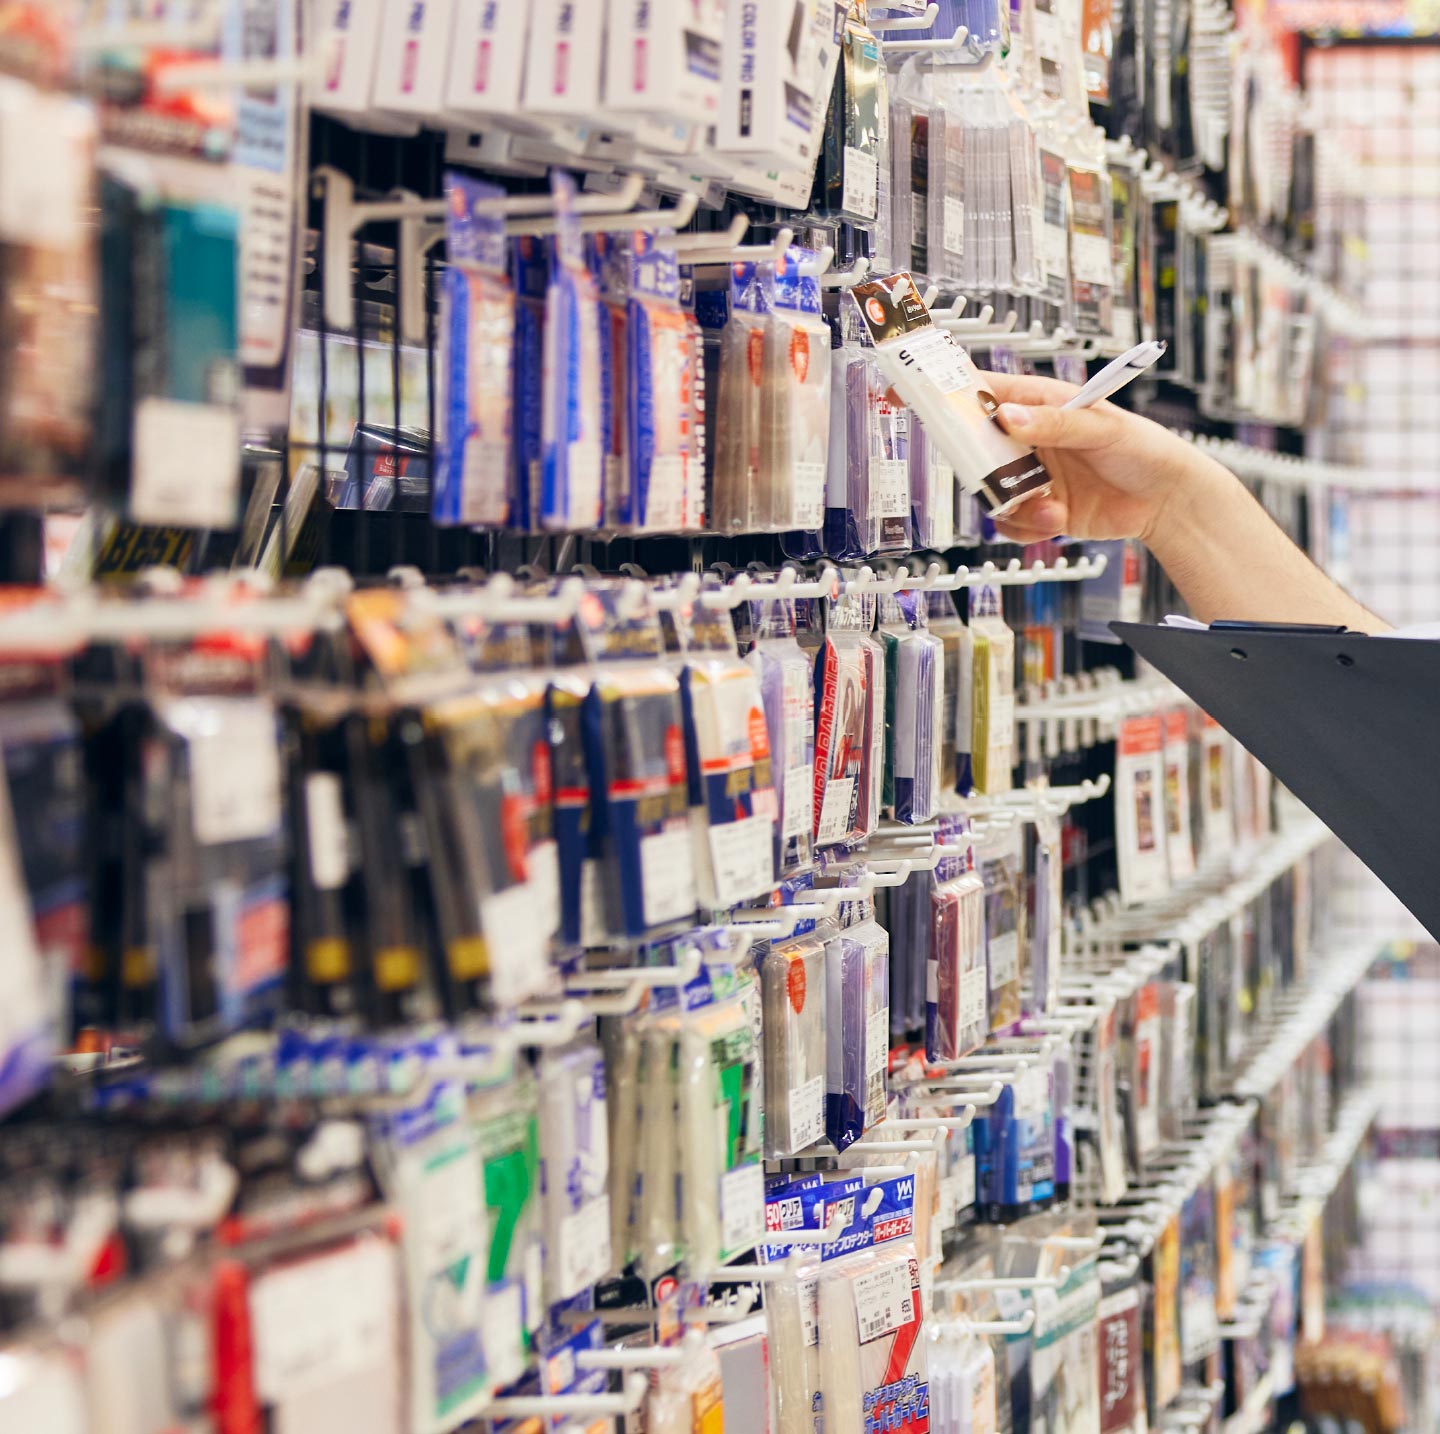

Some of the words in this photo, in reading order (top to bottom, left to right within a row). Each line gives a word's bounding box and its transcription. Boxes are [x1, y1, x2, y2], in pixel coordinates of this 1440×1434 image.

[742, 2, 757, 49] COLOR
[740, 53, 755, 83] PRO
[766, 1203, 781, 1226] 50
[781, 1200, 801, 1218] クリア
